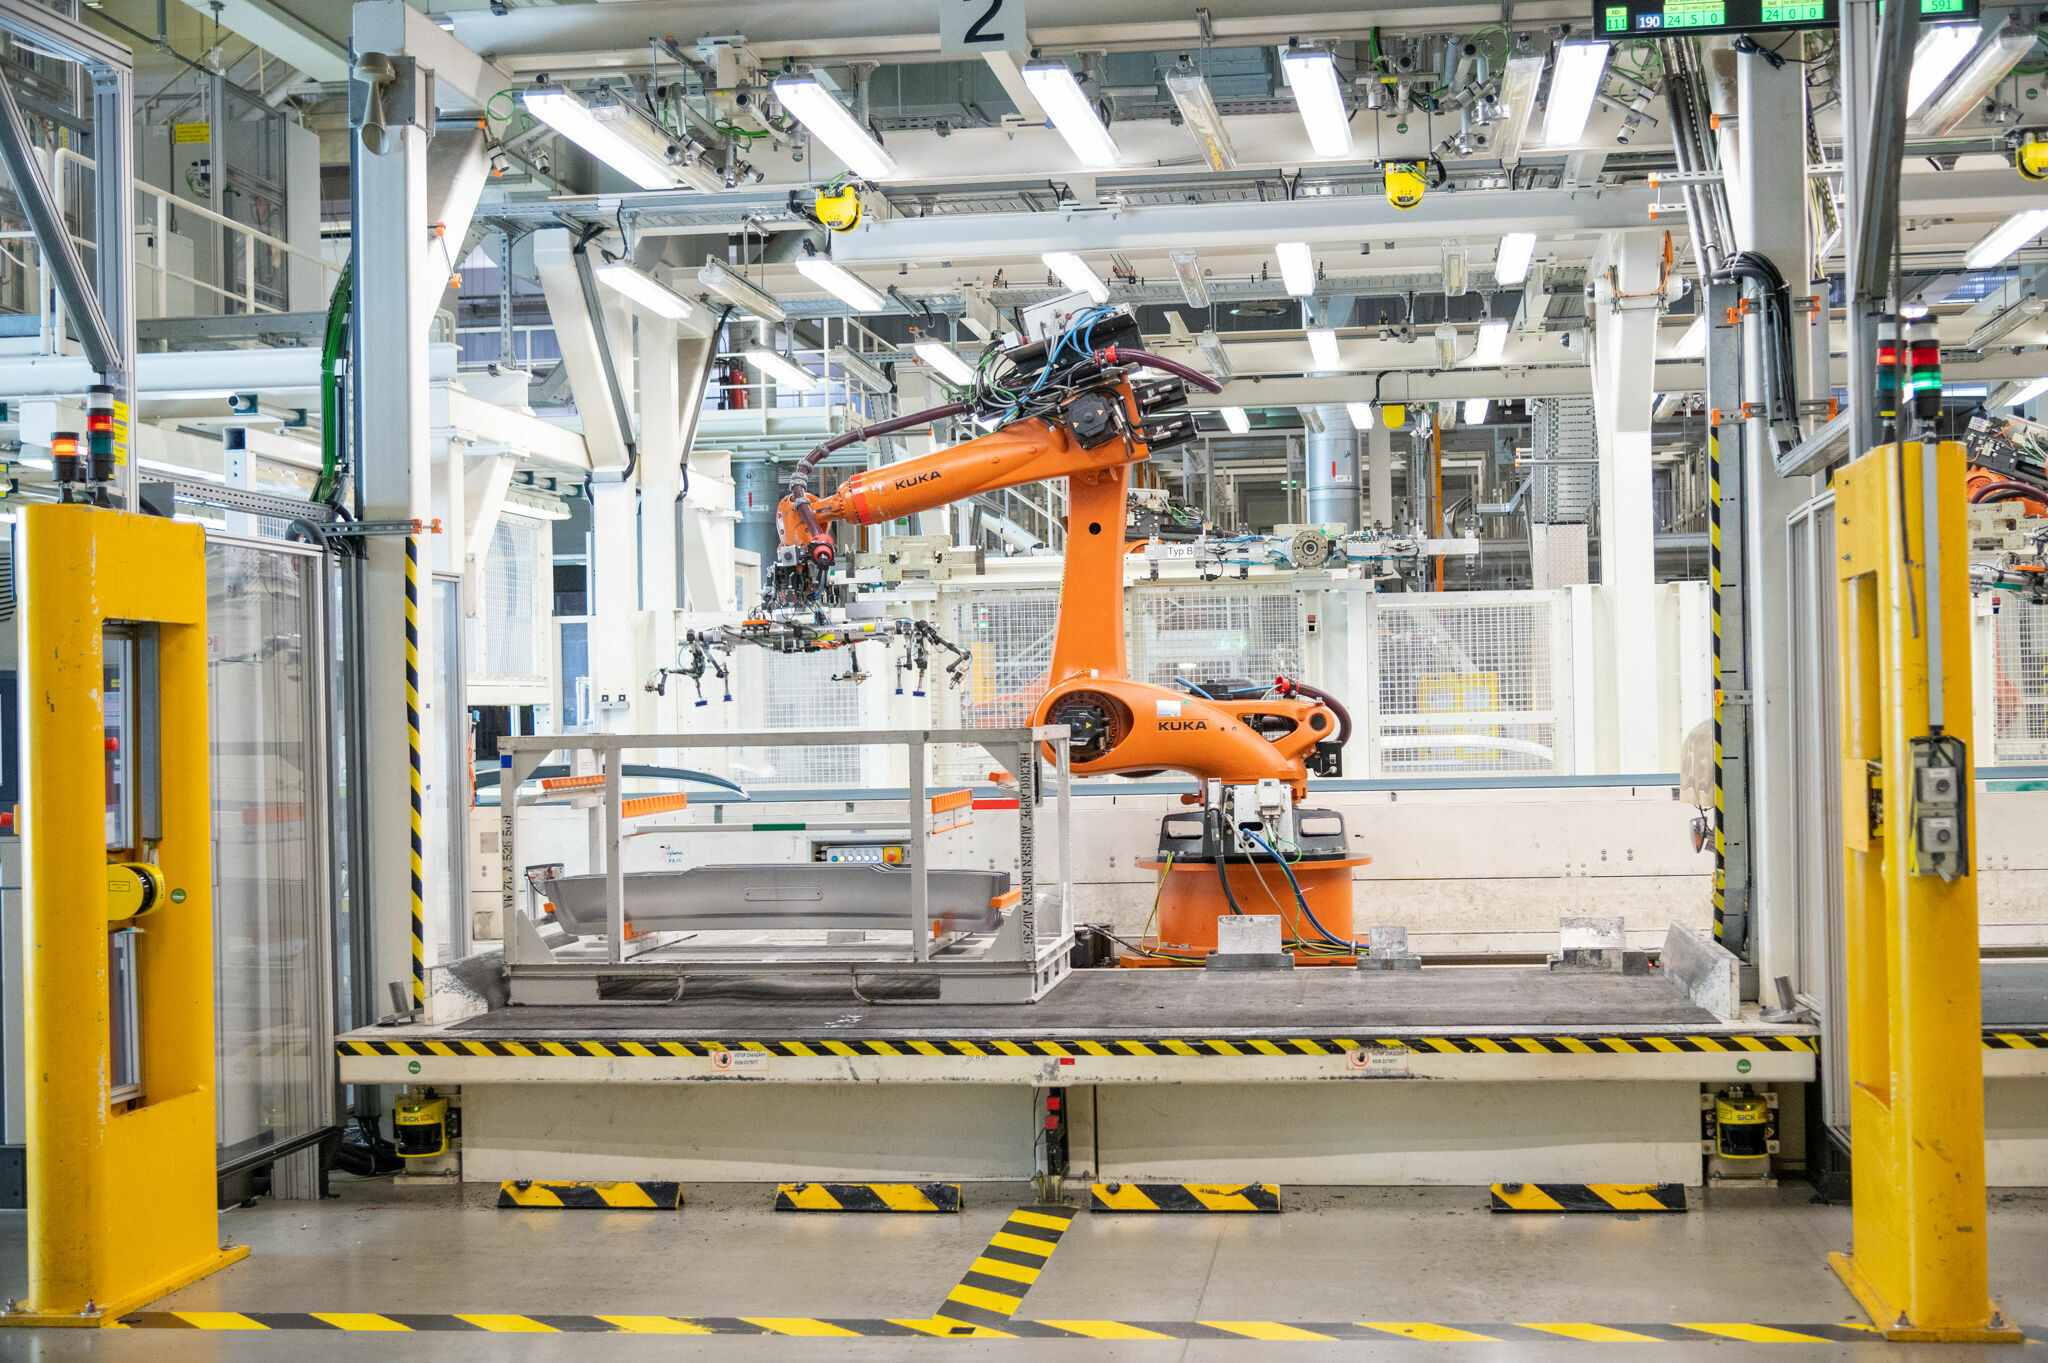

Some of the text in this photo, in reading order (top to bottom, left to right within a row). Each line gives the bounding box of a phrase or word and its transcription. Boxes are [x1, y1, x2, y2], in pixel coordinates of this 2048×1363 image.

[1931, 0, 1952, 11] 591
[1766, 7, 1816, 20] 24 0 0
[962, 0, 1004, 43] 2
[1607, 19, 1626, 30] 111
[1639, 13, 1717, 28] 190 24 5 0
[895, 471, 941, 490] KUKA
[1168, 546, 1194, 557] Typ B
[1158, 721, 1207, 731] KUKA
[1022, 871, 1033, 906] UNTEN
